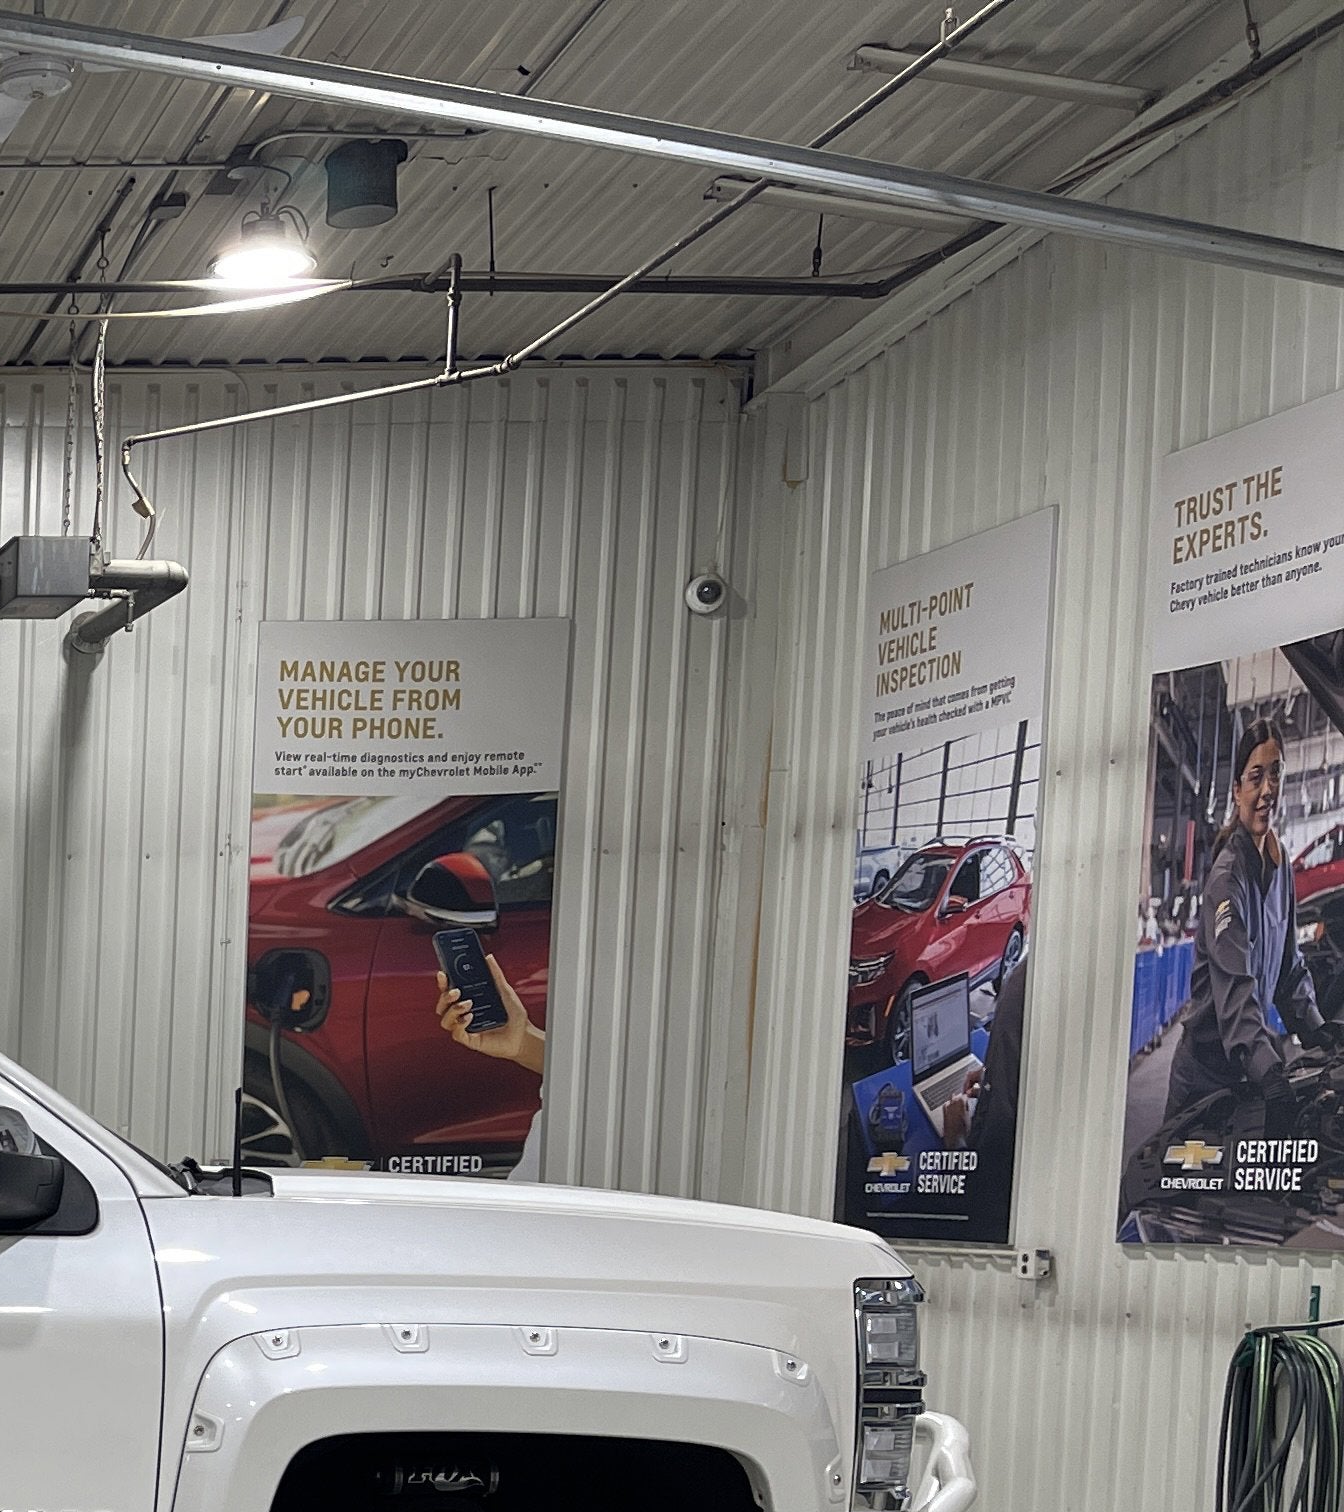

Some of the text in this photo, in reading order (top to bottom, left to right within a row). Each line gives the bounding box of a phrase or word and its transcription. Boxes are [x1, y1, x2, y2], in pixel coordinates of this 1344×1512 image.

[1174, 465, 1283, 528] TRUST THE
[1172, 511, 1268, 564] EXPERTS.
[1170, 577, 1204, 595] Factory
[1206, 564, 1238, 585] trained
[1239, 550, 1293, 576] technicians
[1295, 541, 1321, 559] know
[1170, 561, 1322, 613] Chevy vehicle better than anyone.
[879, 582, 974, 635] MULTI-POINT
[878, 626, 937, 666] VEHICLE
[279, 659, 461, 683] MANAGE YOUR
[876, 650, 962, 697] INSPECTION
[278, 688, 461, 711] VEHICLE FROM
[874, 712, 885, 723] The
[906, 702, 914, 714] of
[932, 695, 946, 707] that
[970, 685, 988, 697] from
[916, 714, 937, 727] health
[939, 703, 966, 722] checked
[968, 700, 983, 714] with
[277, 716, 444, 739] YOUR PHONE.
[275, 751, 525, 765] View real-time diagnostics and enjoy remote
[309, 766, 357, 777] available
[361, 768, 374, 777] on
[377, 767, 396, 777] the
[399, 766, 470, 779] myChevrolet
[473, 765, 509, 776] Mobile
[919, 1151, 978, 1170] CERTIFIED
[1236, 1139, 1319, 1163] CERTIFIED
[388, 1155, 483, 1173] CERTIFIED
[864, 1182, 911, 1193] CHEVROLET
[917, 1174, 966, 1194] SERVICE
[1160, 1177, 1224, 1190] CHEVROLET
[1234, 1167, 1302, 1191] SERVICE
